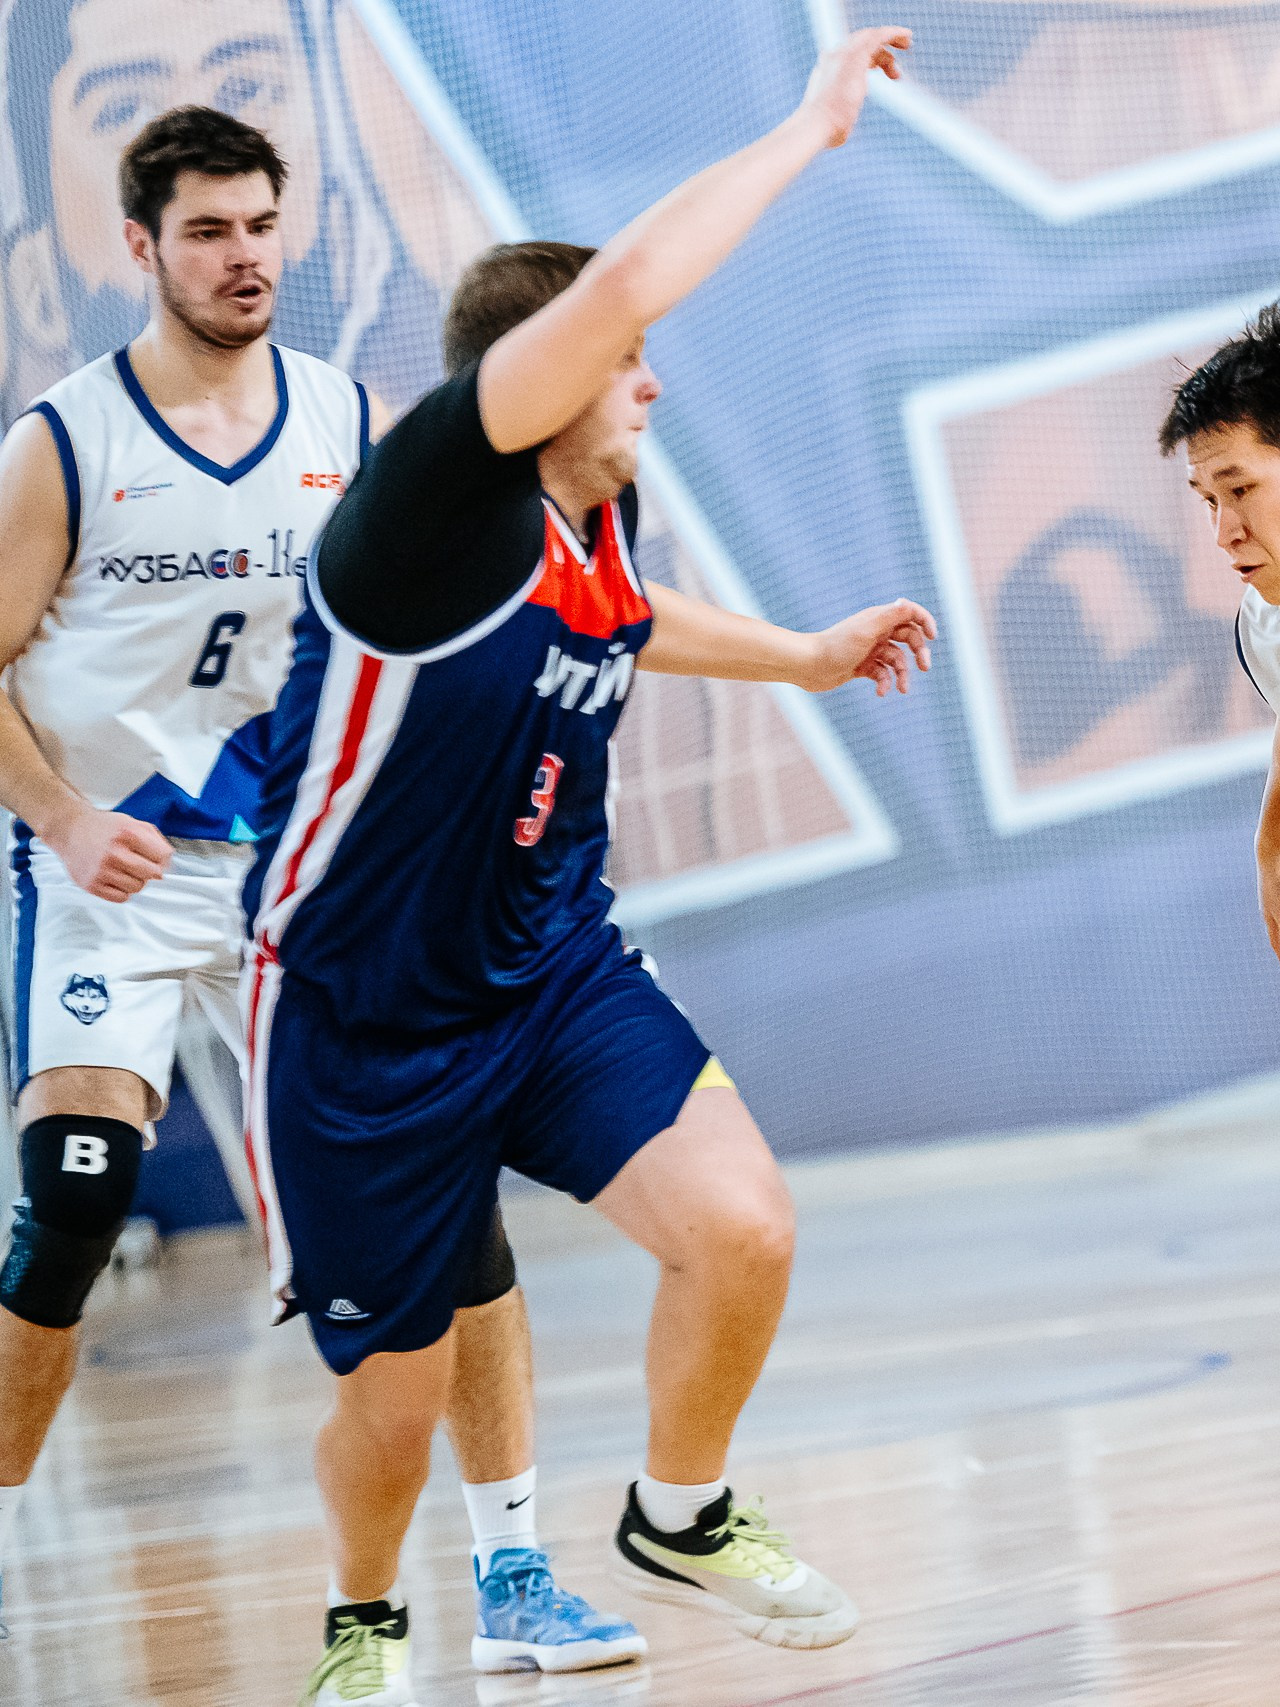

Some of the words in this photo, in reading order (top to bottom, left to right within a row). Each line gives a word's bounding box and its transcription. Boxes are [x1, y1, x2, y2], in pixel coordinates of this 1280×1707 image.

[187, 610, 246, 689] 6
[512, 753, 565, 847] 3
[62, 1134, 110, 1175] B
